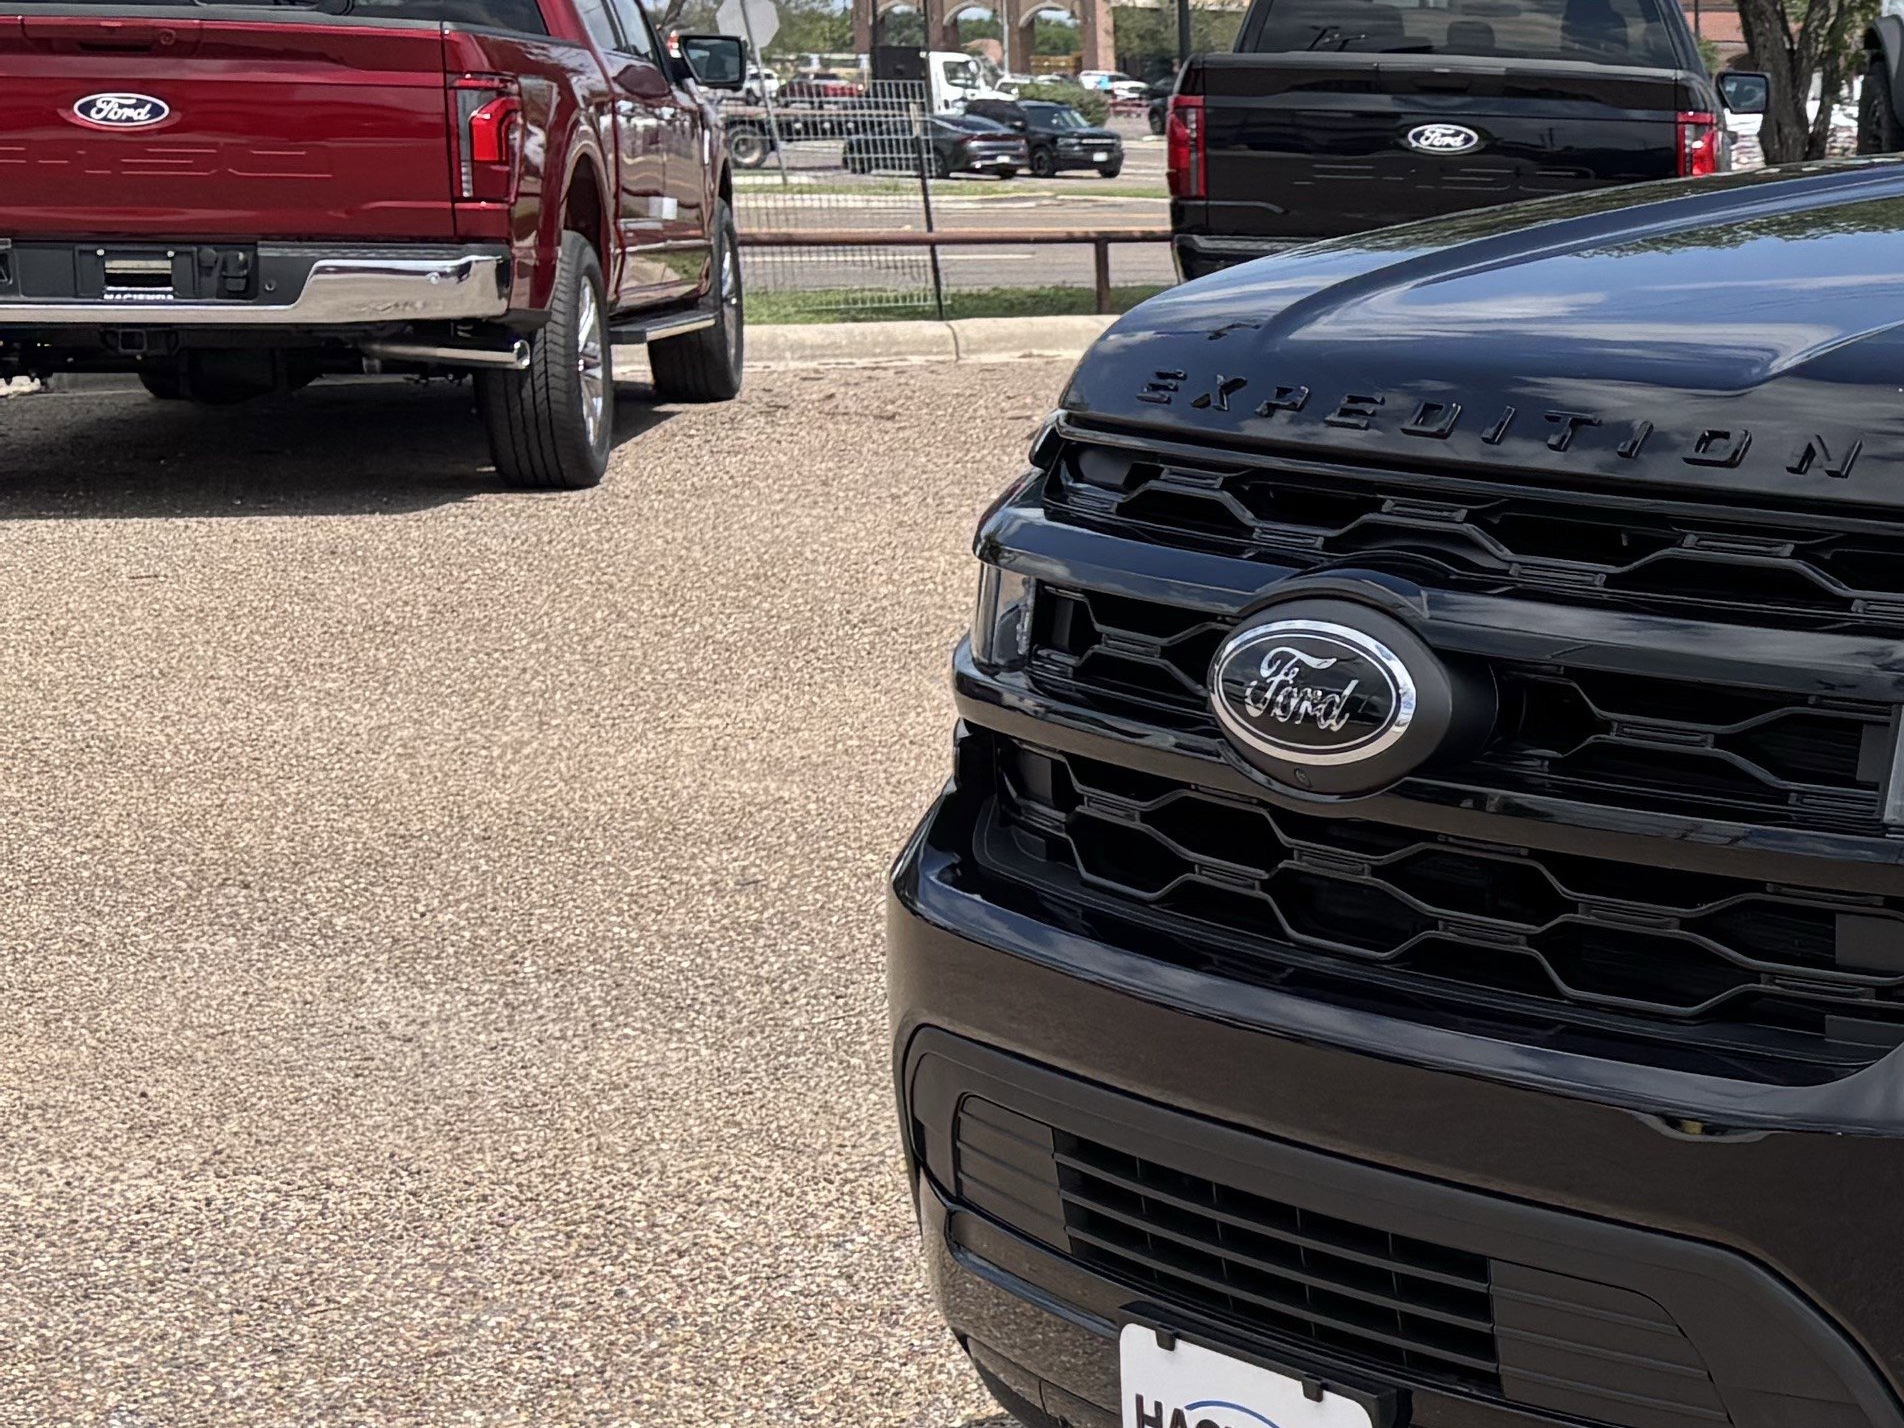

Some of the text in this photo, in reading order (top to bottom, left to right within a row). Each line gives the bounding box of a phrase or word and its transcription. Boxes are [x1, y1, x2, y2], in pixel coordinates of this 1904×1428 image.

[90, 97, 152, 120] Ford
[1420, 127, 1466, 146] Ford
[1136, 370, 1864, 479] EXPEDITION
[1244, 646, 1360, 733] Ford
